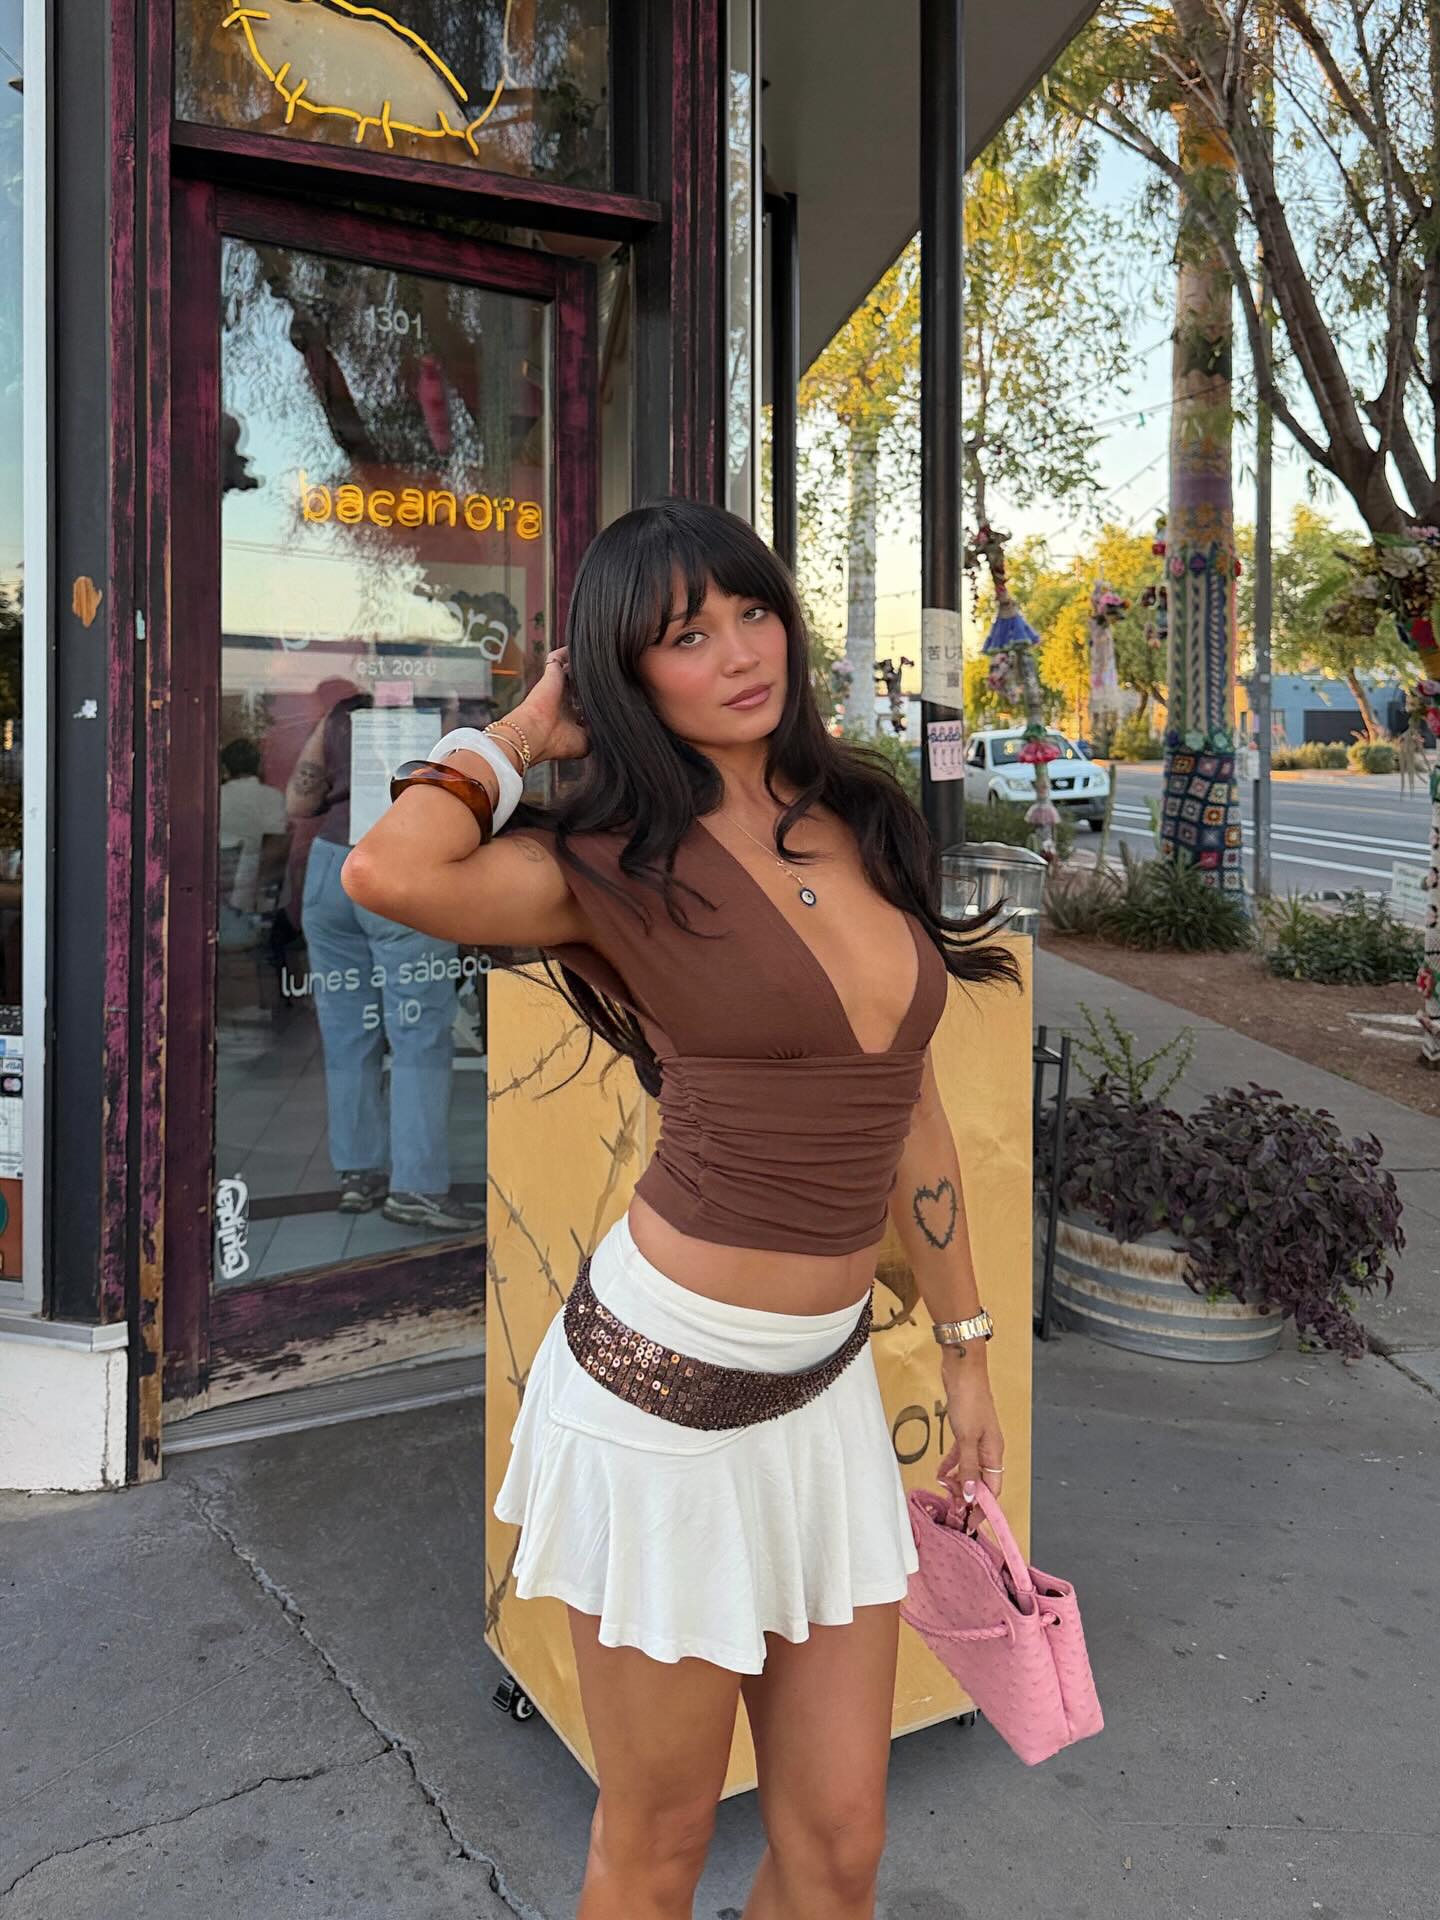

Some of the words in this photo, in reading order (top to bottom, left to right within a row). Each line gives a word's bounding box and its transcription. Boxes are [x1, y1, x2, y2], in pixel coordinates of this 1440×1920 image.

[364, 304, 421, 339] 1301
[299, 469, 543, 540] bacanora
[357, 656, 385, 676] est
[282, 966, 360, 997] lunes
[370, 965, 387, 987] a
[399, 948, 492, 984] sábado
